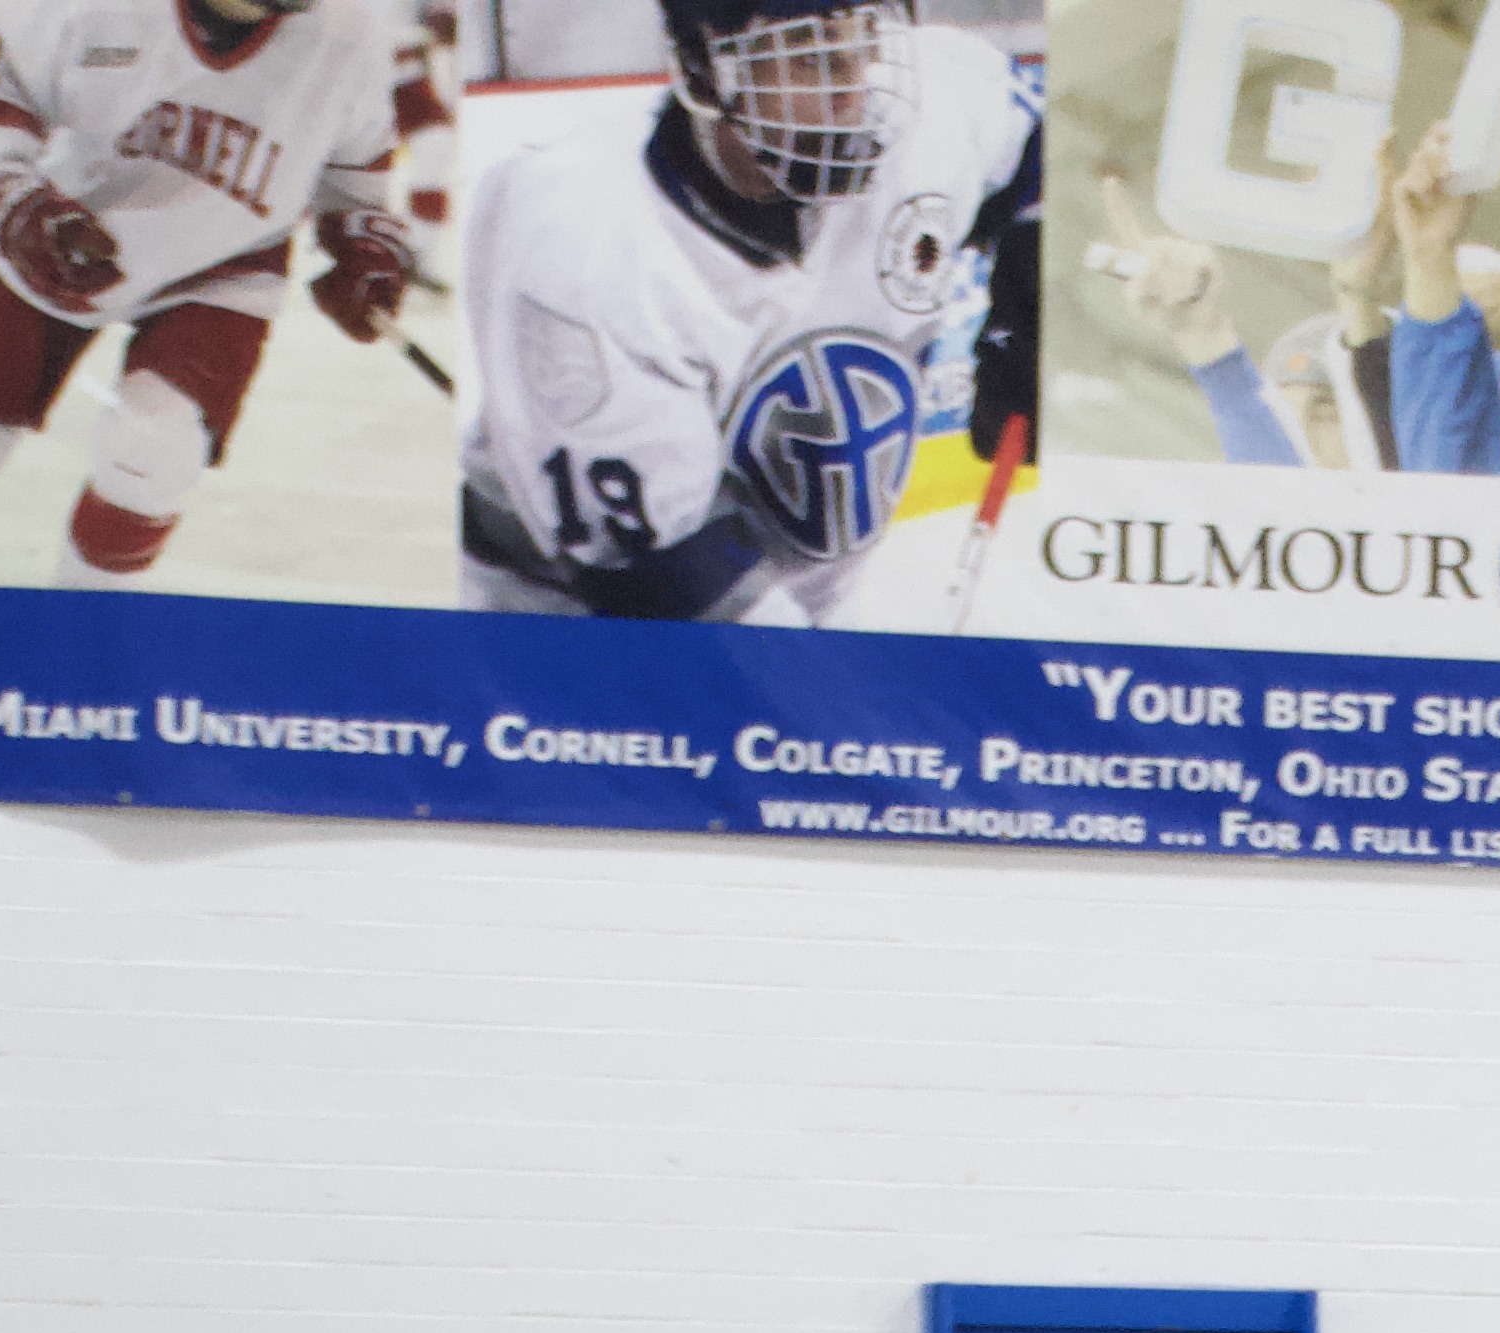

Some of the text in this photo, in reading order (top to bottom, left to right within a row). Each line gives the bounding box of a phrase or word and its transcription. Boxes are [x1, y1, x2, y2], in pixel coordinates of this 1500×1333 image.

[540, 445, 660, 552] 19
[1040, 516, 1483, 600] GILMOUR
[1264, 687, 1397, 733] BEST
[1277, 750, 1409, 801] OHIO
